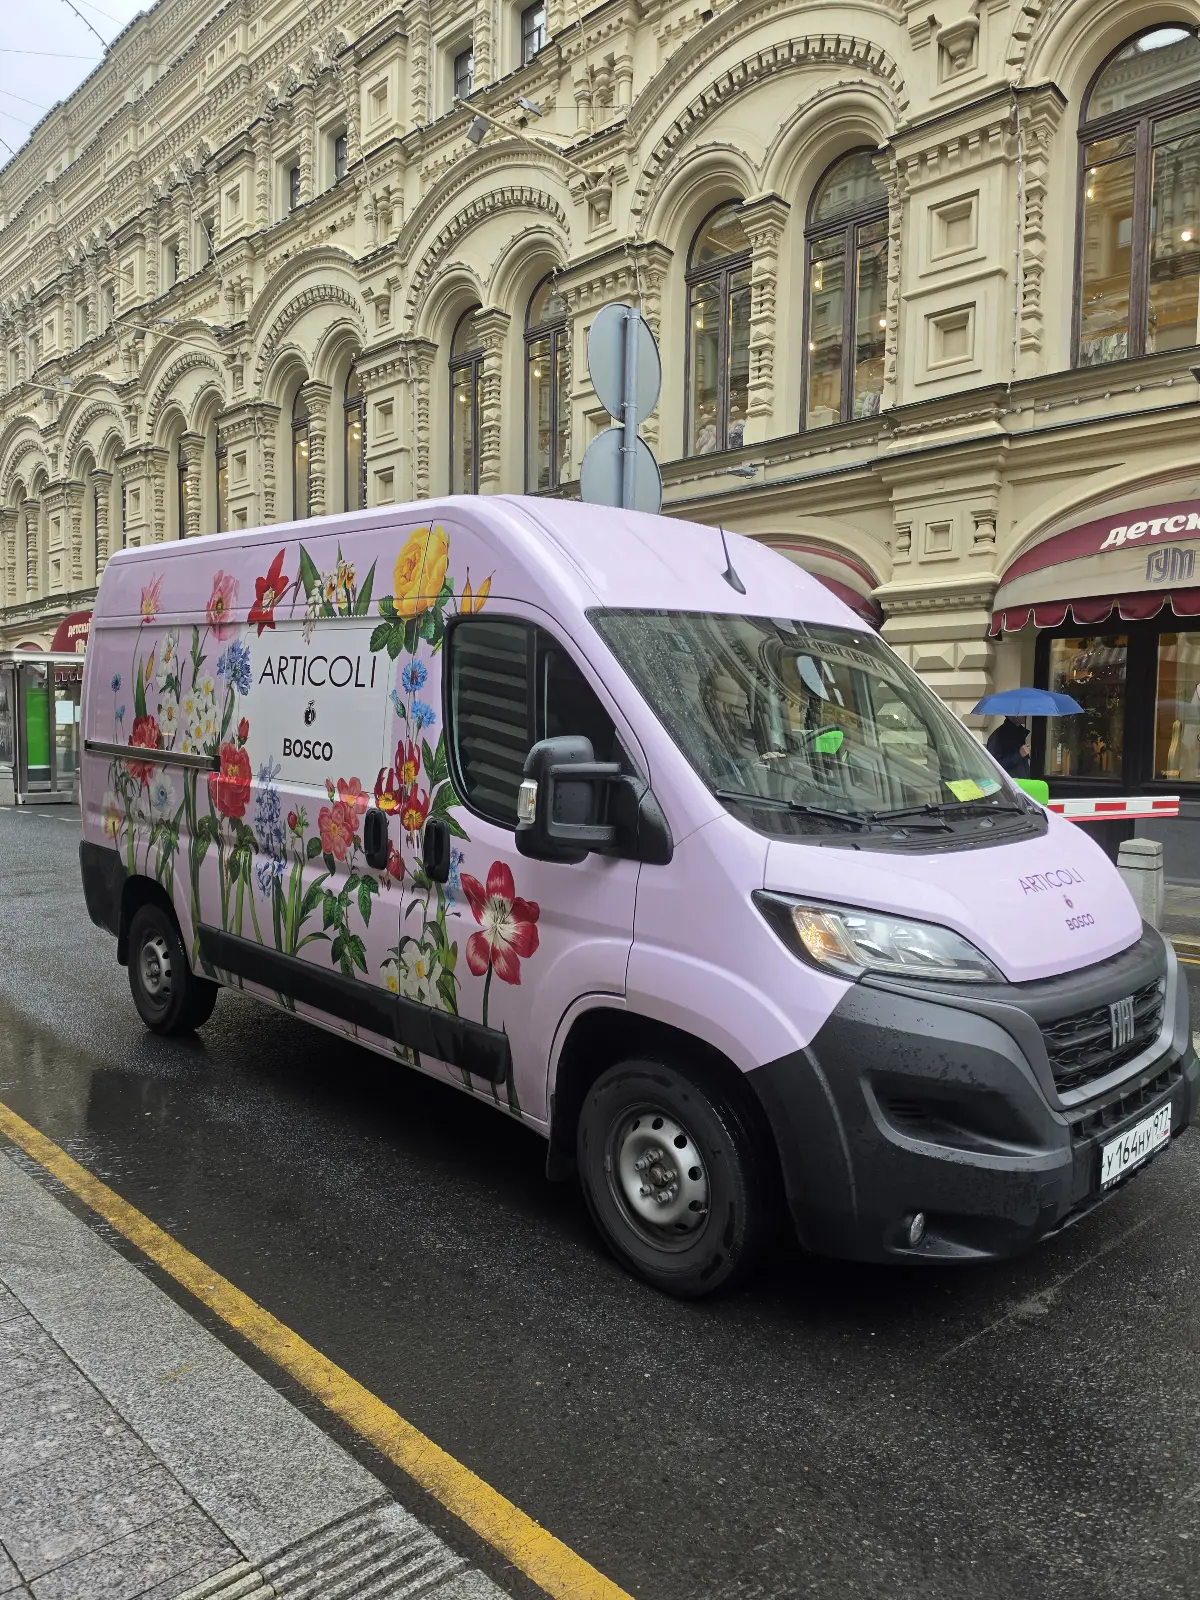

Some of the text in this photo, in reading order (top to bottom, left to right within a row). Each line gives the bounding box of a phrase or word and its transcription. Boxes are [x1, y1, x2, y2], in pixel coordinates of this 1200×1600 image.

[258, 655, 377, 688] ARTICOLI
[282, 737, 333, 761] BOSCO
[1018, 867, 1086, 895] ARTICOLI
[1065, 913, 1095, 930] BOSCO
[1109, 995, 1135, 1050] FIAT
